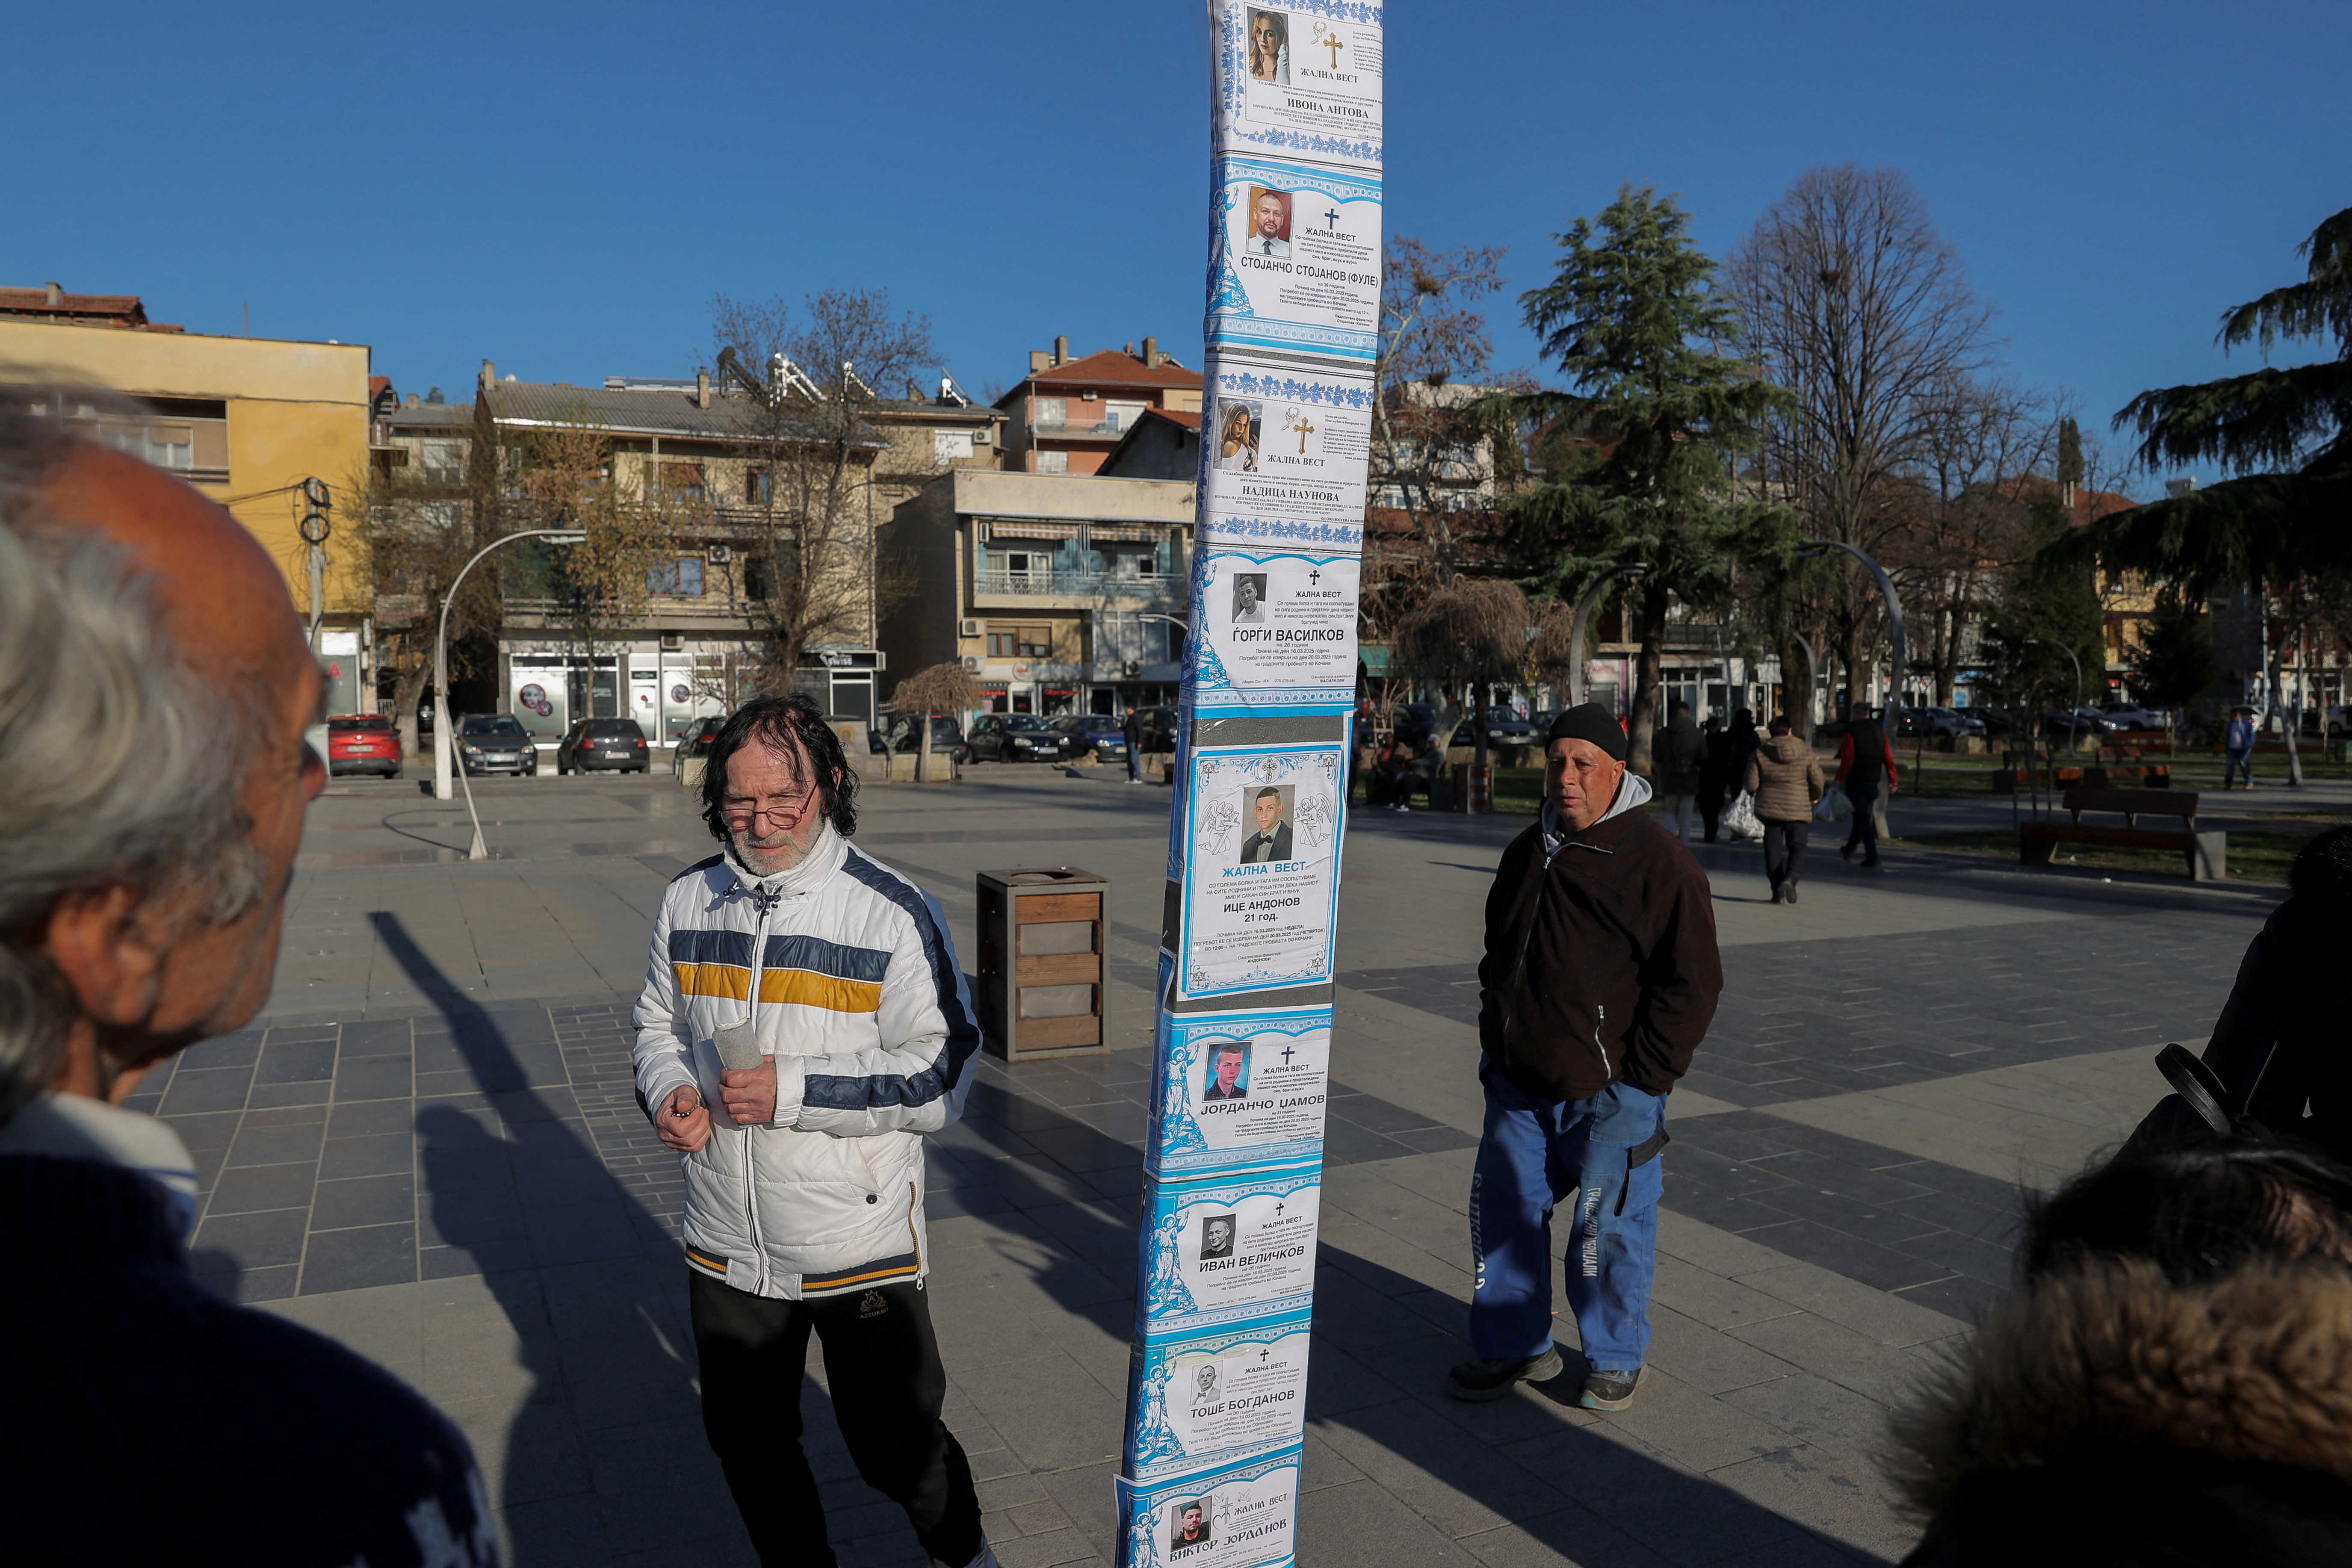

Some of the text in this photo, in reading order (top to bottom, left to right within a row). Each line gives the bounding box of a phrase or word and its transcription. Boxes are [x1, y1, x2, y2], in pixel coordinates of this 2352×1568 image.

[1300, 68, 1359, 83] ЖАЛНА ВЕСТ
[1287, 98, 1368, 118] ИВОНА АНТОВА
[1305, 227, 1356, 242] ЖАЛНА ВЕСТ
[1241, 256, 1378, 288] СТОЈАНЧО СТОЈАНОВ (ФУЛЕ)
[1267, 454, 1325, 467] ЖАЛНА ВЕСТ
[1242, 485, 1339, 502] НАДИЦА НАУНОВА
[1233, 626, 1344, 642] ЃОРЃИ ВАСИЛКОВ
[1222, 861, 1306, 877] ЖАЛНА ВЕСТ
[1279, 874, 1316, 882] СООПШТУВАМЕ
[1223, 897, 1300, 913] ИЦЕ АНДОНОВ
[1244, 913, 1278, 922] 21 год.
[1262, 1066, 1289, 1075] ЖАЛНА
[1200, 1094, 1324, 1115] ЈОРДАНЧО ЏАМОВ
[1262, 1216, 1302, 1230] ЖАЛНА ВЕСТ
[1199, 1245, 1304, 1273] ИВАН ВЕЛИЧКОВ
[860, 1308, 889, 1319] AZZURRO
[1244, 1365, 1269, 1374] ЖАЛНА
[1190, 1390, 1294, 1418] ТОШЕ БОГДАНОВ
[1234, 1493, 1287, 1516] ЖАЛНА ВЕСТ
[1170, 1539, 1218, 1562] ВИКТОР
